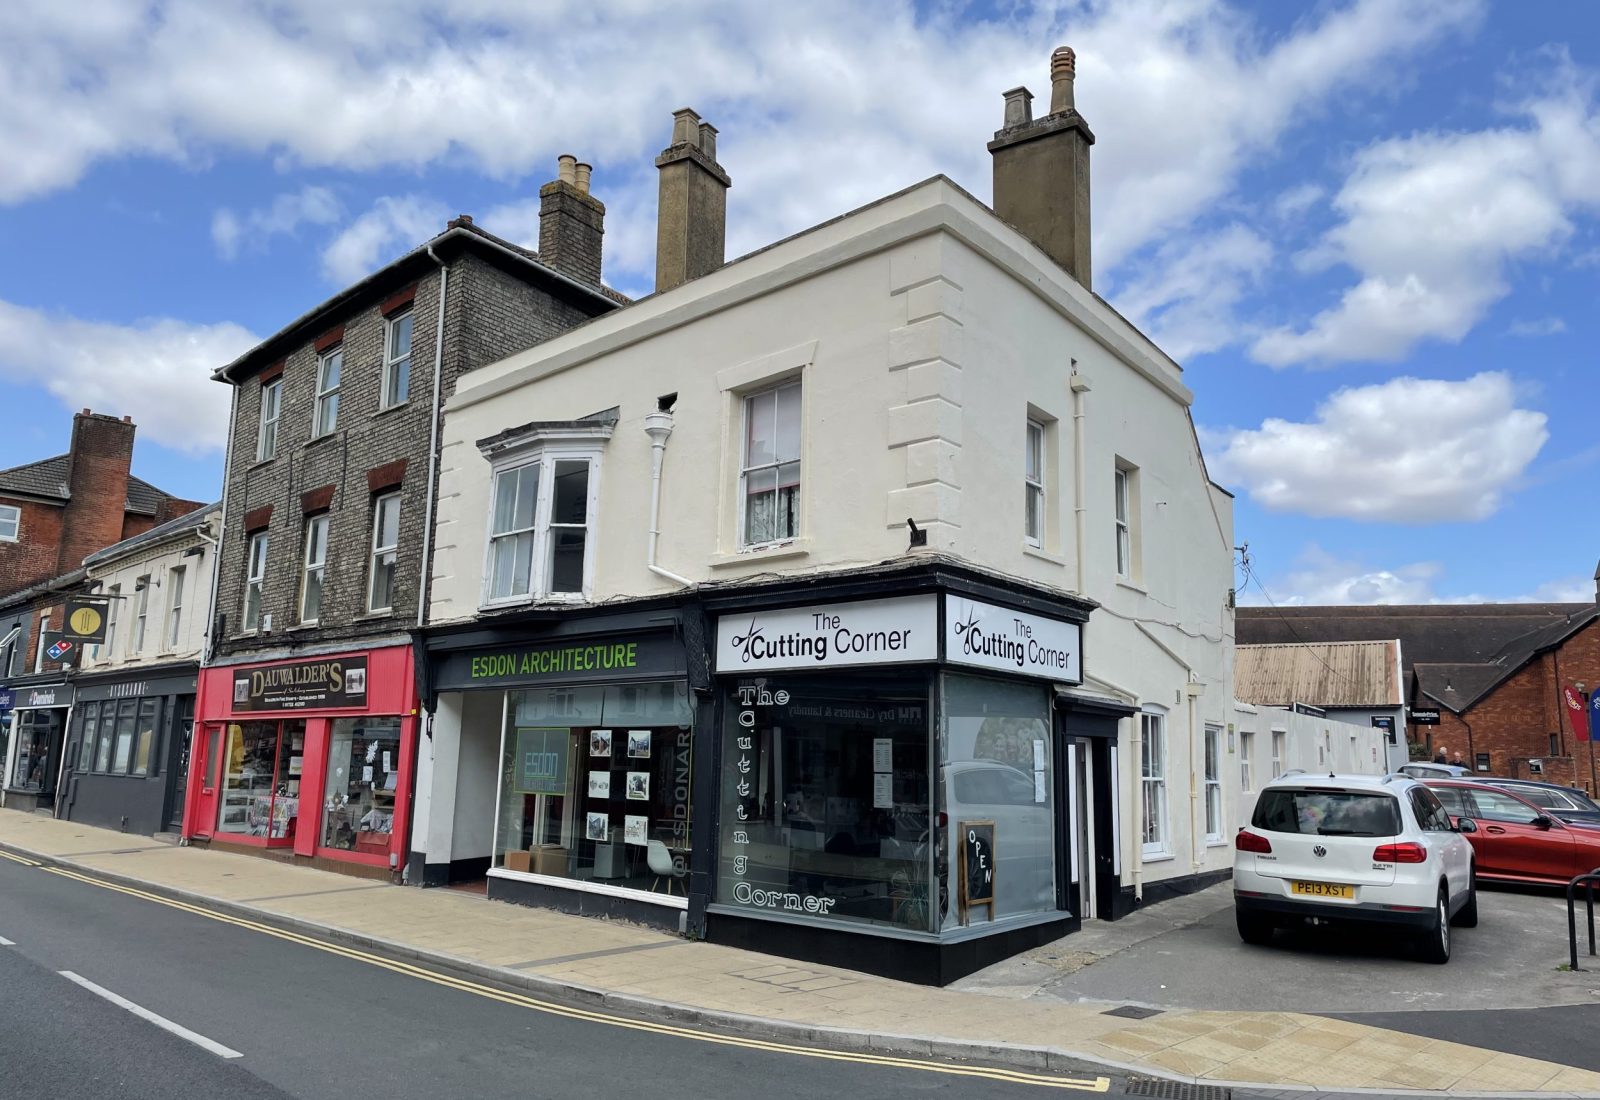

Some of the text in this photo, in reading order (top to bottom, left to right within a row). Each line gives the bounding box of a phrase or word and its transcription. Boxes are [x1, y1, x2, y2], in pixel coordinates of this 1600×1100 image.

[812, 613, 841, 630] The
[1013, 618, 1032, 639] The
[471, 643, 638, 678] ESDON ARCHITECTURE
[751, 628, 911, 661] Cutting Corner
[970, 627, 1070, 669] Cutting Corner
[250, 662, 343, 697] DAUWALDER'S
[738, 684, 790, 706] The
[969, 830, 992, 883] OPEN
[733, 882, 835, 914] Corner
[1297, 882, 1346, 897] PE13 XST
